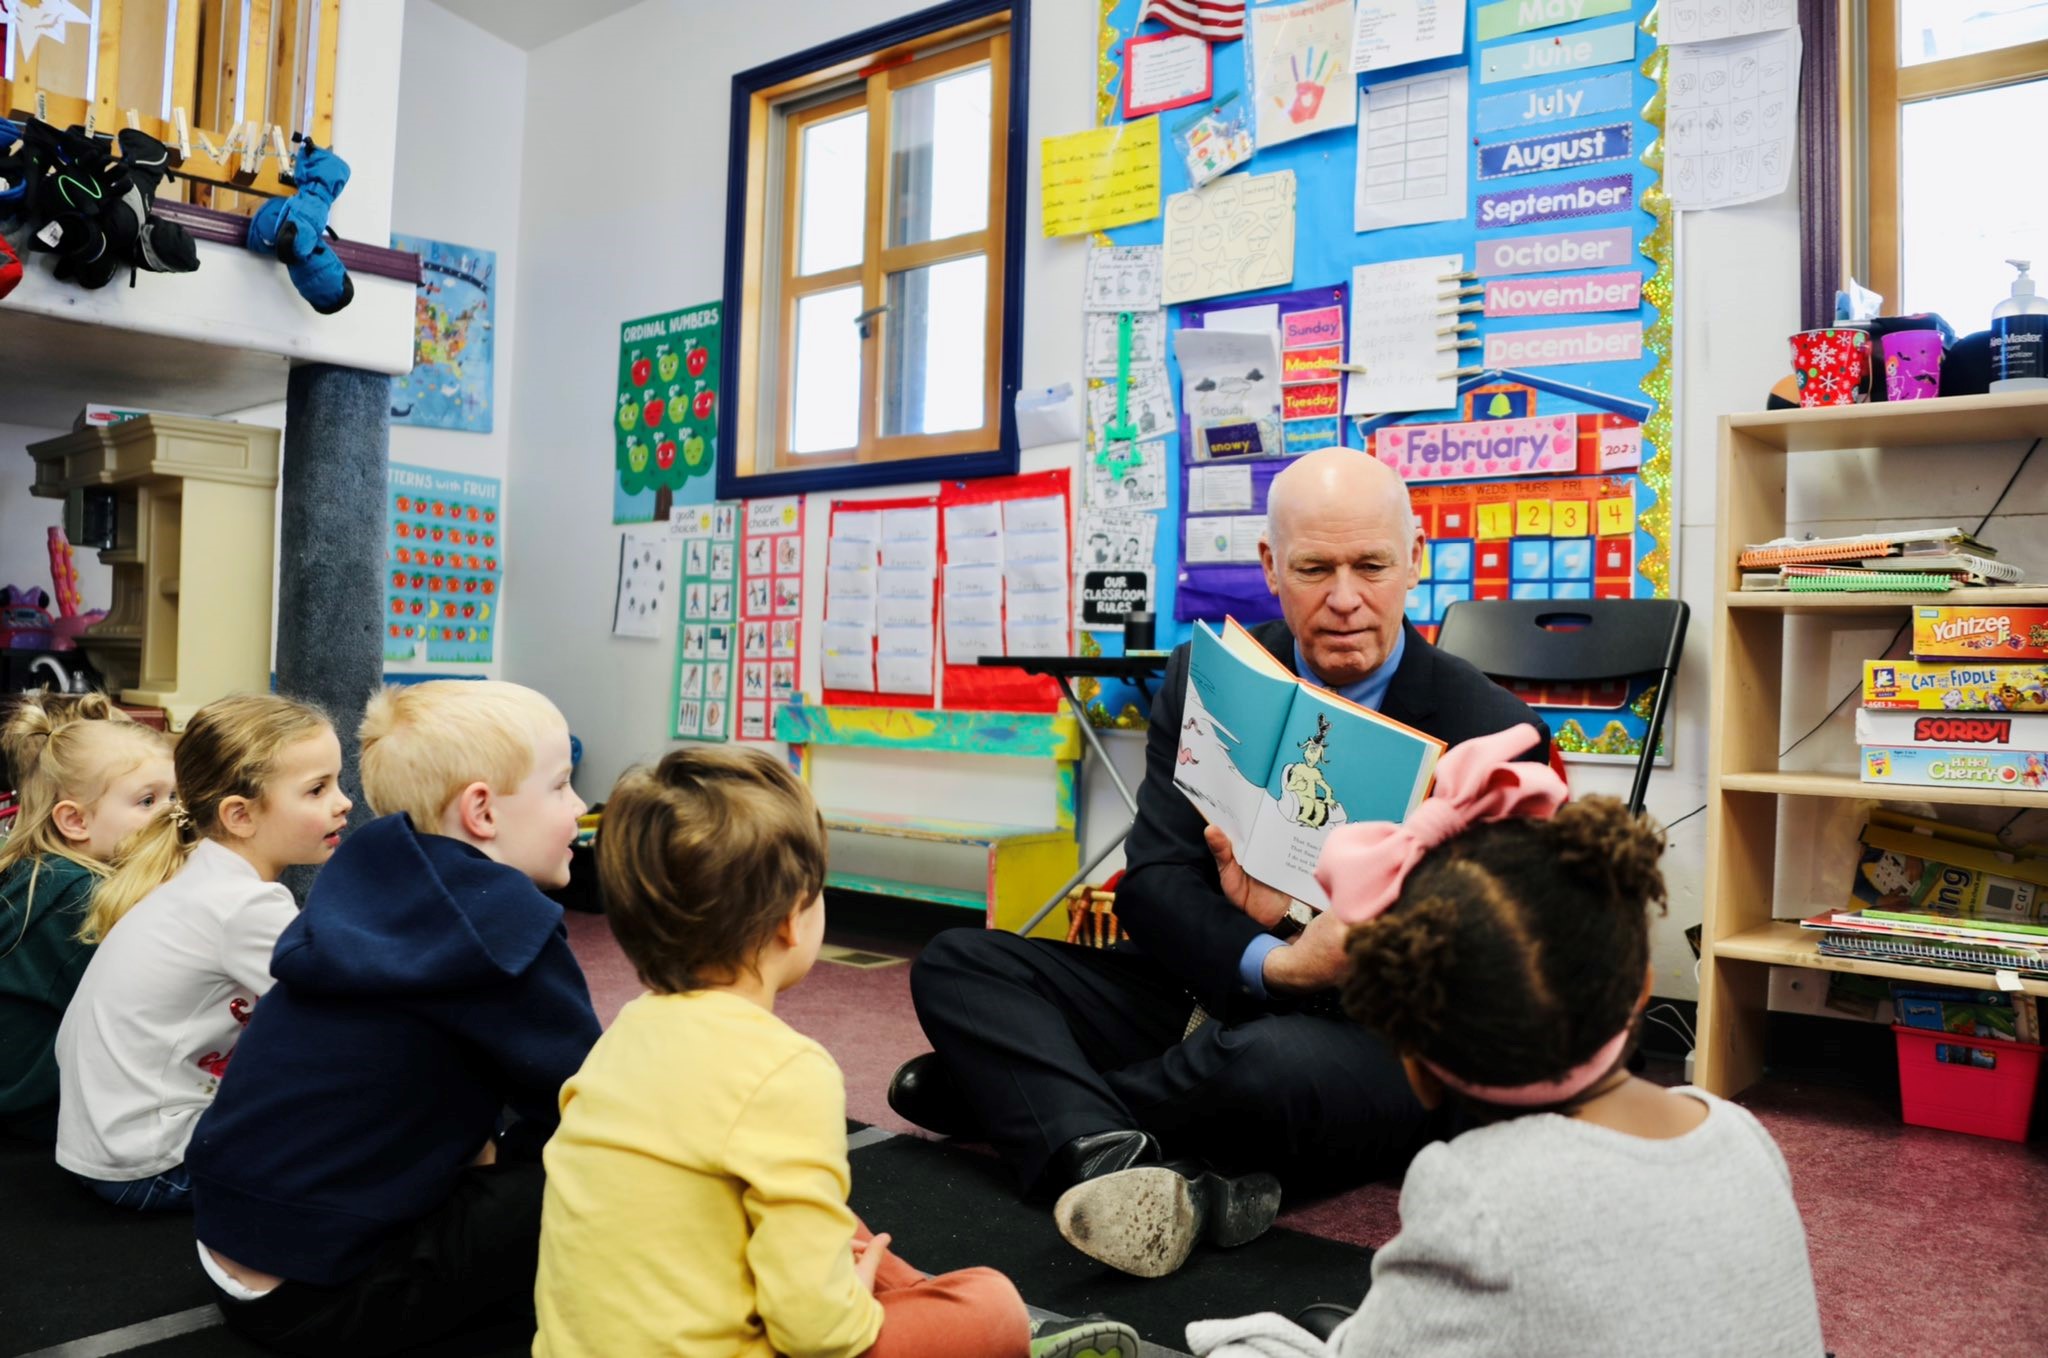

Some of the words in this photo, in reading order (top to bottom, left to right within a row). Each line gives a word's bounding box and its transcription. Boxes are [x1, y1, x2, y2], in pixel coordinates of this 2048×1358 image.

[1518, 0, 1585, 26] May
[1522, 41, 1592, 70] June
[1523, 89, 1584, 119] July
[1501, 131, 1606, 170] August
[1482, 186, 1627, 222] September
[1494, 239, 1612, 267] October
[1489, 281, 1635, 310] November
[624, 320, 666, 342] ORDINAL
[669, 308, 719, 334] NUMBERS
[1288, 321, 1338, 338] Sunday
[1490, 331, 1637, 361] December
[1286, 393, 1336, 409] Tuesday
[1210, 439, 1250, 454] snowy
[1287, 429, 1336, 442] Wednesday
[1407, 429, 1549, 469] February
[1605, 443, 1637, 456] 2023
[387, 468, 432, 489] TTERNS
[435, 480, 460, 491] with
[464, 480, 497, 499] FRUIT
[754, 504, 774, 515] poor
[1490, 512, 1496, 532] 1
[1528, 506, 1540, 526] 2
[1564, 508, 1576, 527] 3
[1609, 505, 1622, 524] 4
[1084, 586, 1146, 602] CLASSROOM
[1103, 576, 1127, 589] OUR
[1932, 616, 2010, 643] Yahtzee
[1911, 676, 1935, 690] CAT
[1951, 669, 1997, 687] FIDDLE
[1914, 717, 2012, 744] SORRY!
[1952, 757, 1967, 767] Hi
[1968, 758, 1989, 769] Ho!
[2015, 886, 2028, 911] car
